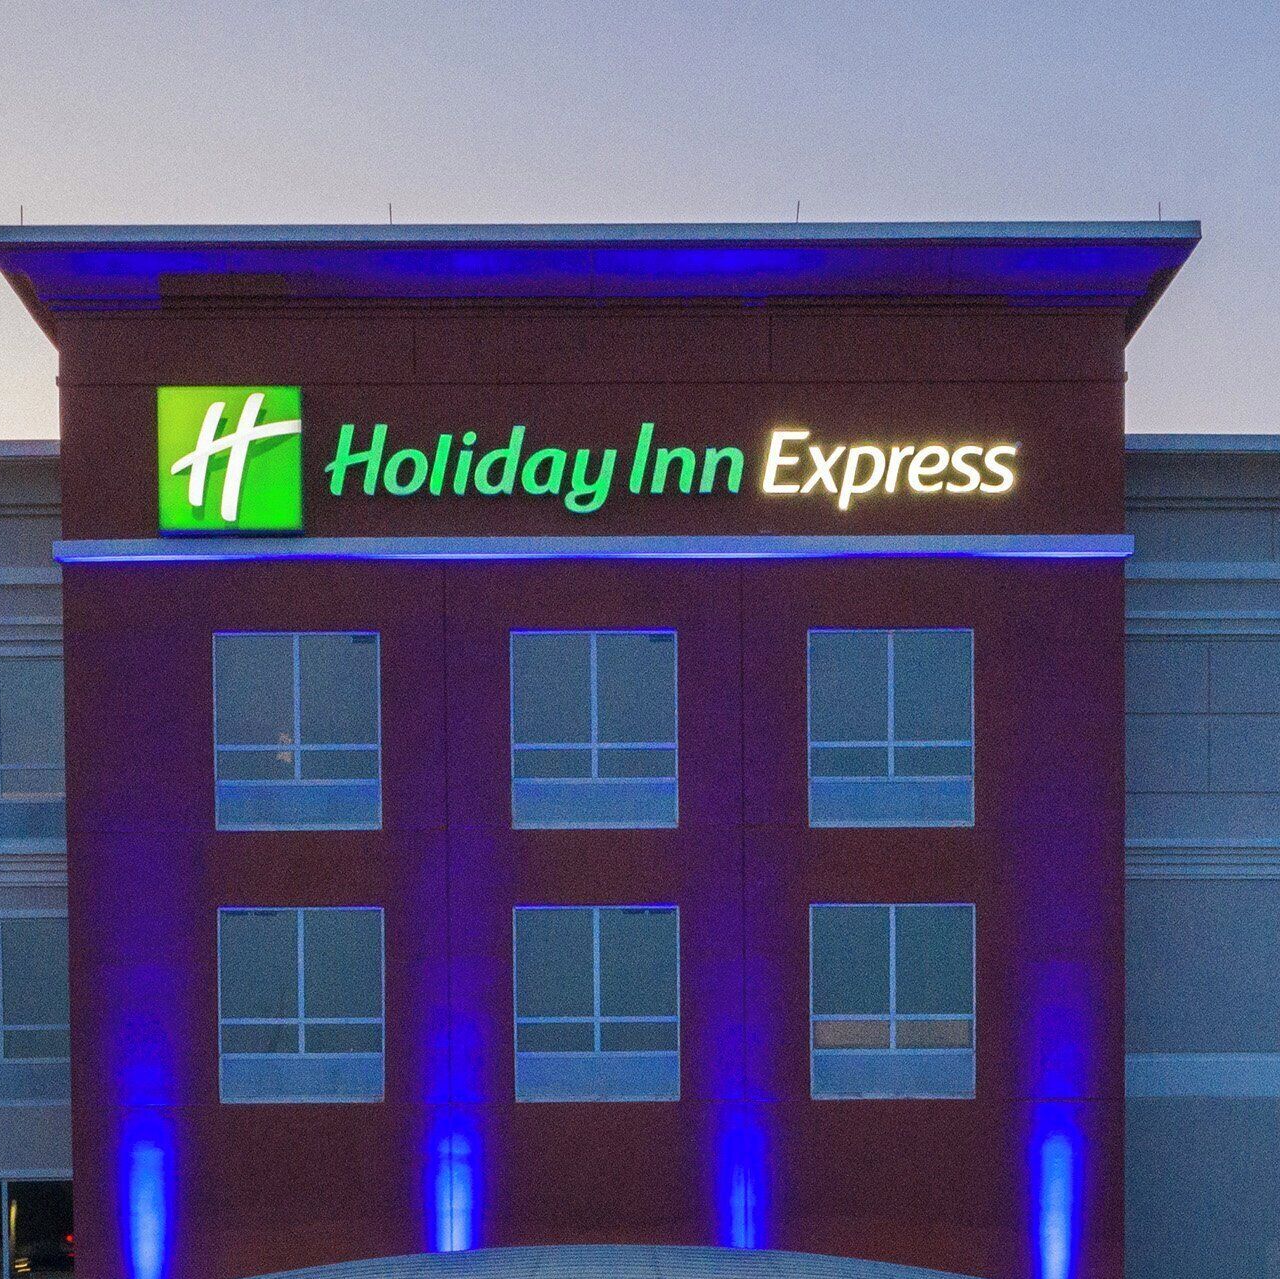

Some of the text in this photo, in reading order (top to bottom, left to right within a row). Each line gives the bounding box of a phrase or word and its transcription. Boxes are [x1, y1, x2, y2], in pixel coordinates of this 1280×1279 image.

[324, 422, 1018, 514] Holiday Inn Express
